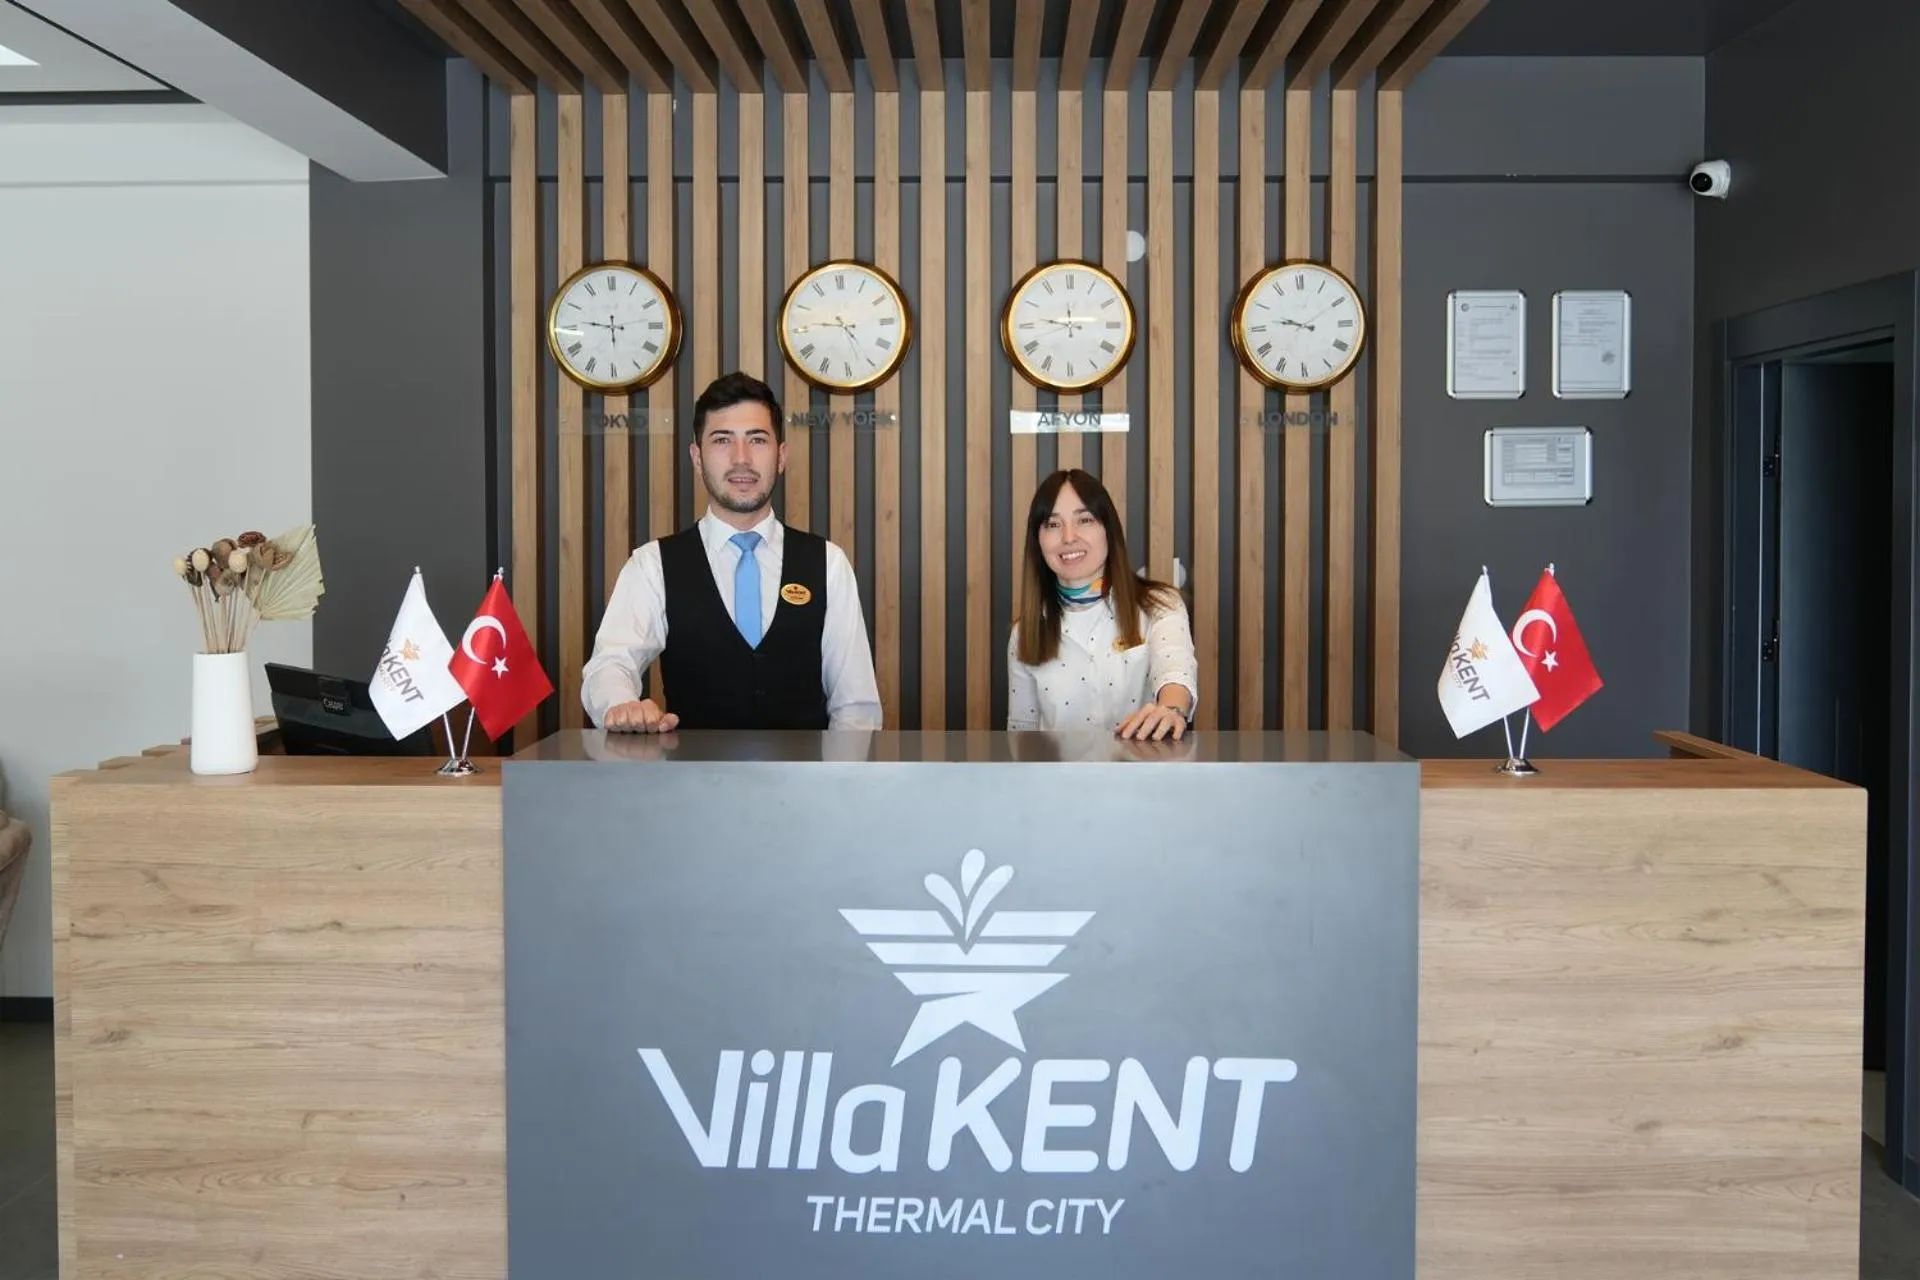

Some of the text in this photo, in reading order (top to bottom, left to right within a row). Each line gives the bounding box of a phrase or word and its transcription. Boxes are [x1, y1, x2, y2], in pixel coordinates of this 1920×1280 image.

[1037, 411, 1101, 426] AFYON
[1257, 411, 1338, 427] LONDON
[637, 1048, 1298, 1174] Villa KENT
[807, 1195, 1125, 1235] THERMAL CITY
